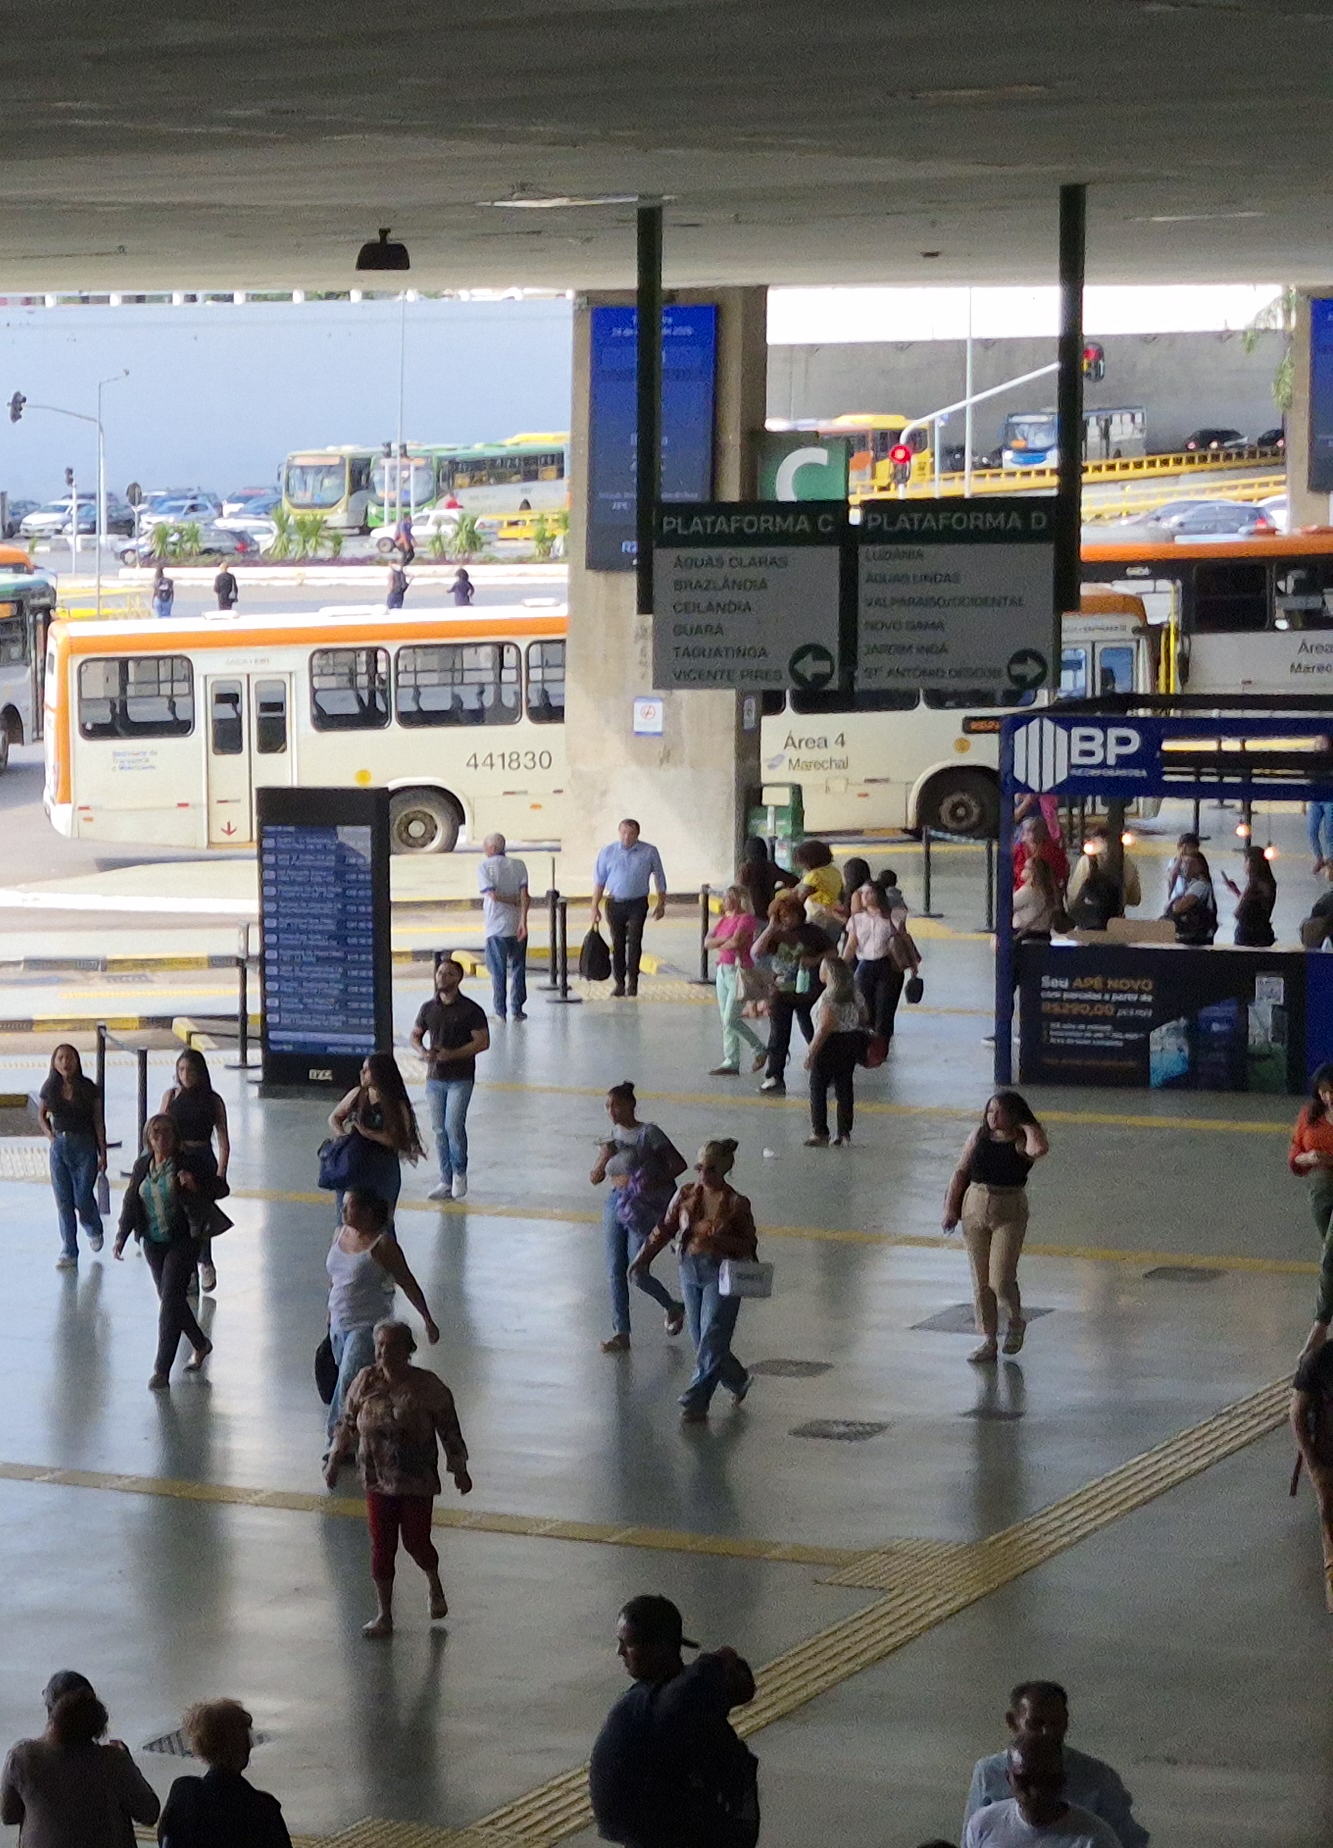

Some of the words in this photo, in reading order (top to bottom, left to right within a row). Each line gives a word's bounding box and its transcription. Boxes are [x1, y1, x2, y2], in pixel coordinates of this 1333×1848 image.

[775, 447, 828, 501] C
[662, 515, 810, 535] PLATAFORMA
[818, 514, 833, 533] C
[867, 511, 1022, 531] PLATAFORMA
[1031, 512, 1047, 530] D
[729, 555, 789, 569] CLARAS
[673, 646, 768, 659] TAGUATINGA
[672, 668, 735, 682] VICENTE
[739, 668, 783, 681] PIRES
[783, 730, 828, 750] Área
[835, 733, 846, 748] 4
[1070, 727, 1140, 766] BP
[466, 751, 552, 771] 441830
[788, 756, 849, 770] Marechal
[1106, 977, 1154, 993] NOVO
